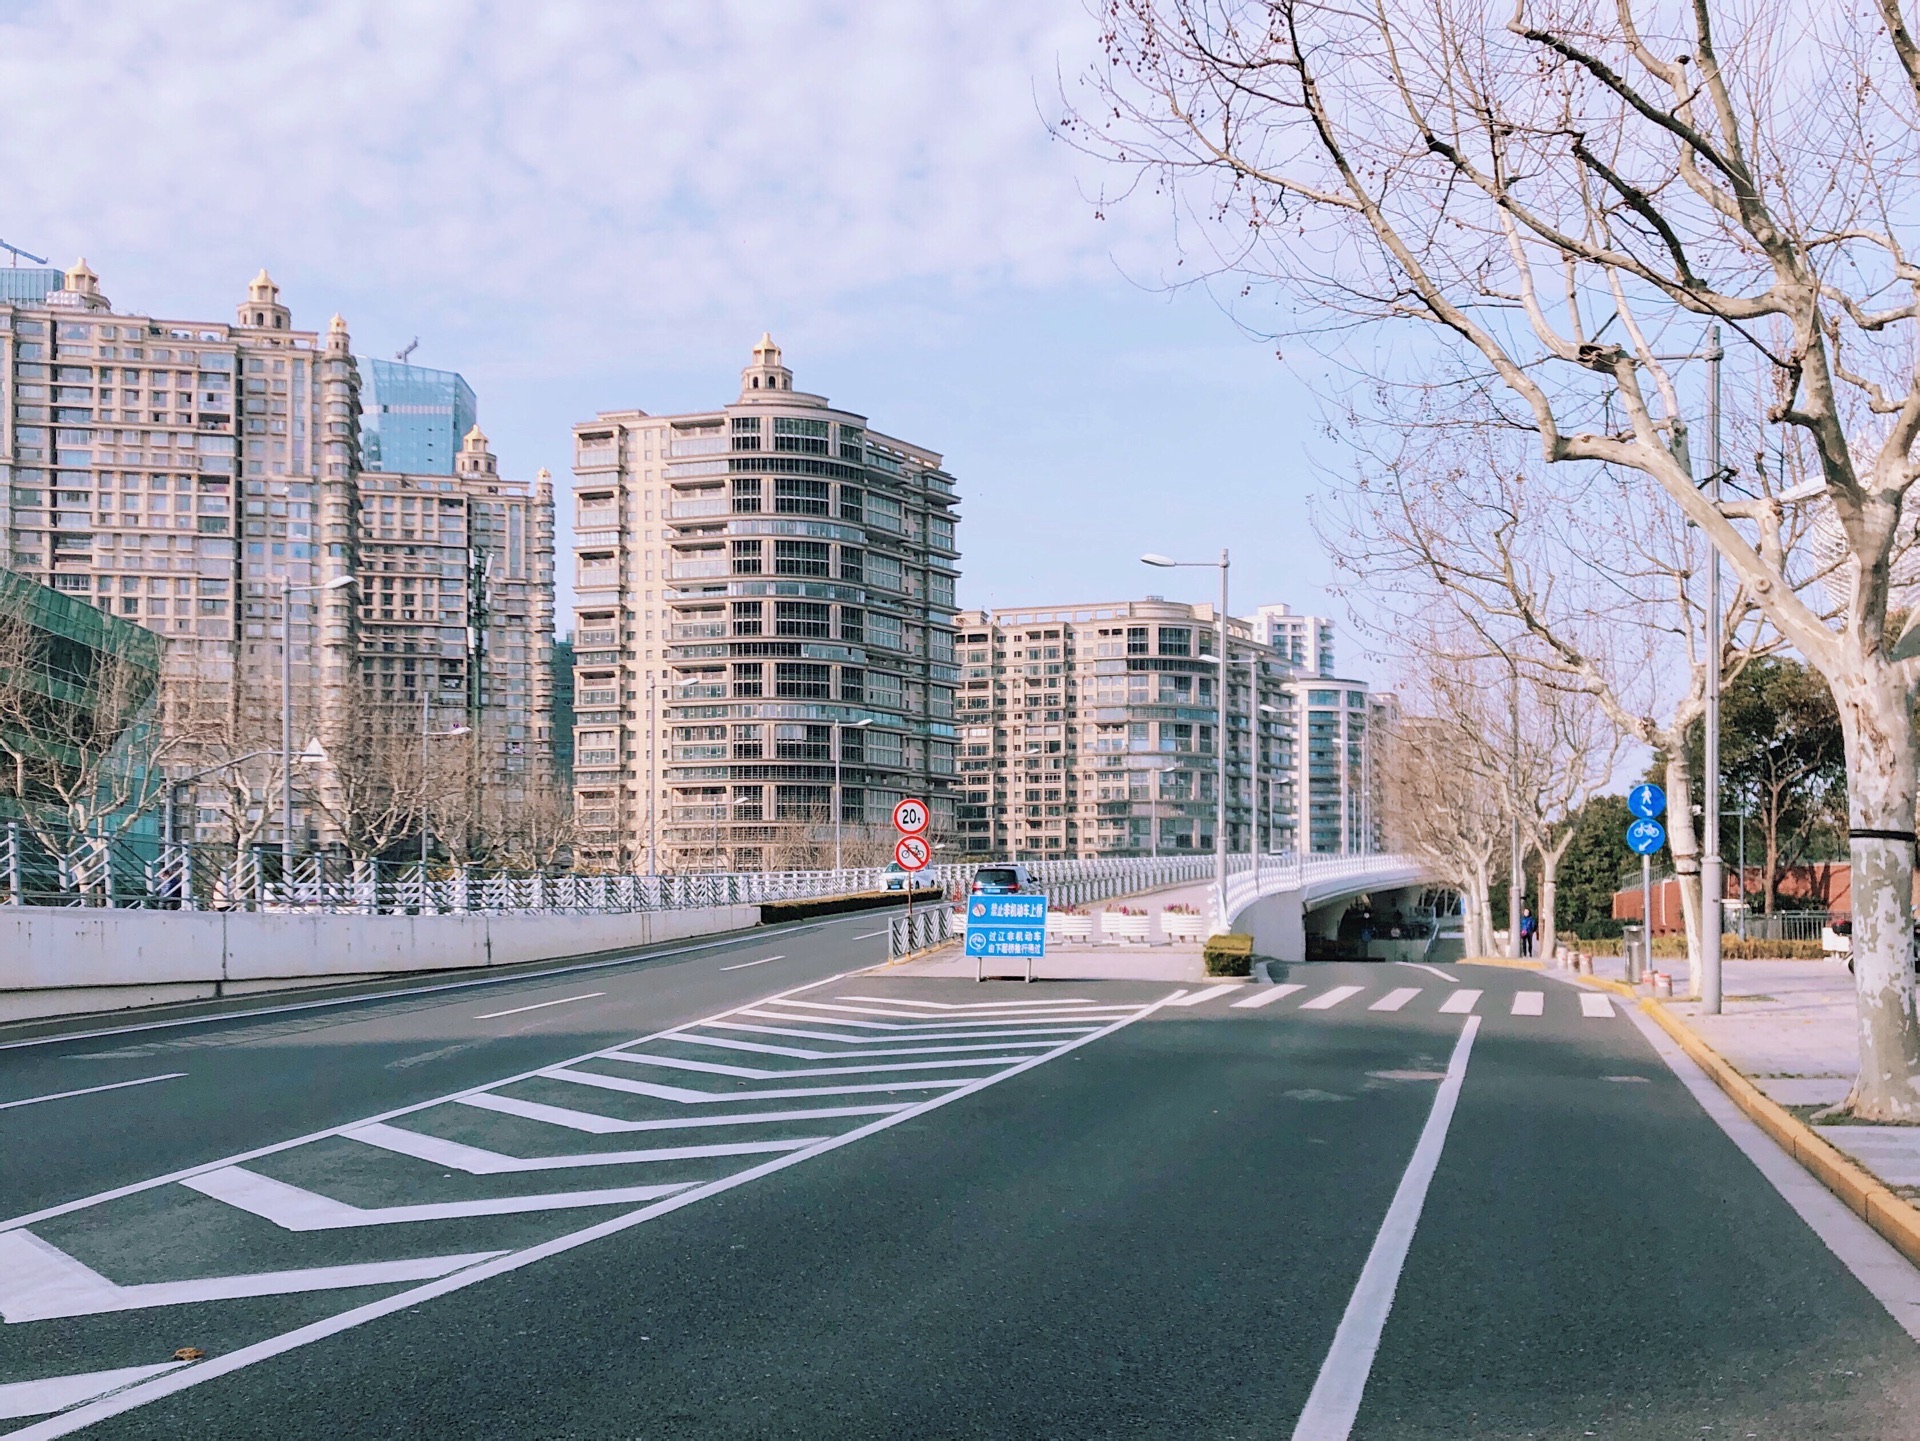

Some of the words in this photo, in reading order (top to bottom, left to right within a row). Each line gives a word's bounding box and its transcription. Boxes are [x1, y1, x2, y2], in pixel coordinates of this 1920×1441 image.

[990, 903, 1043, 917] 禁止非机动车上桥
[989, 931, 1041, 941] 过江非机动车
